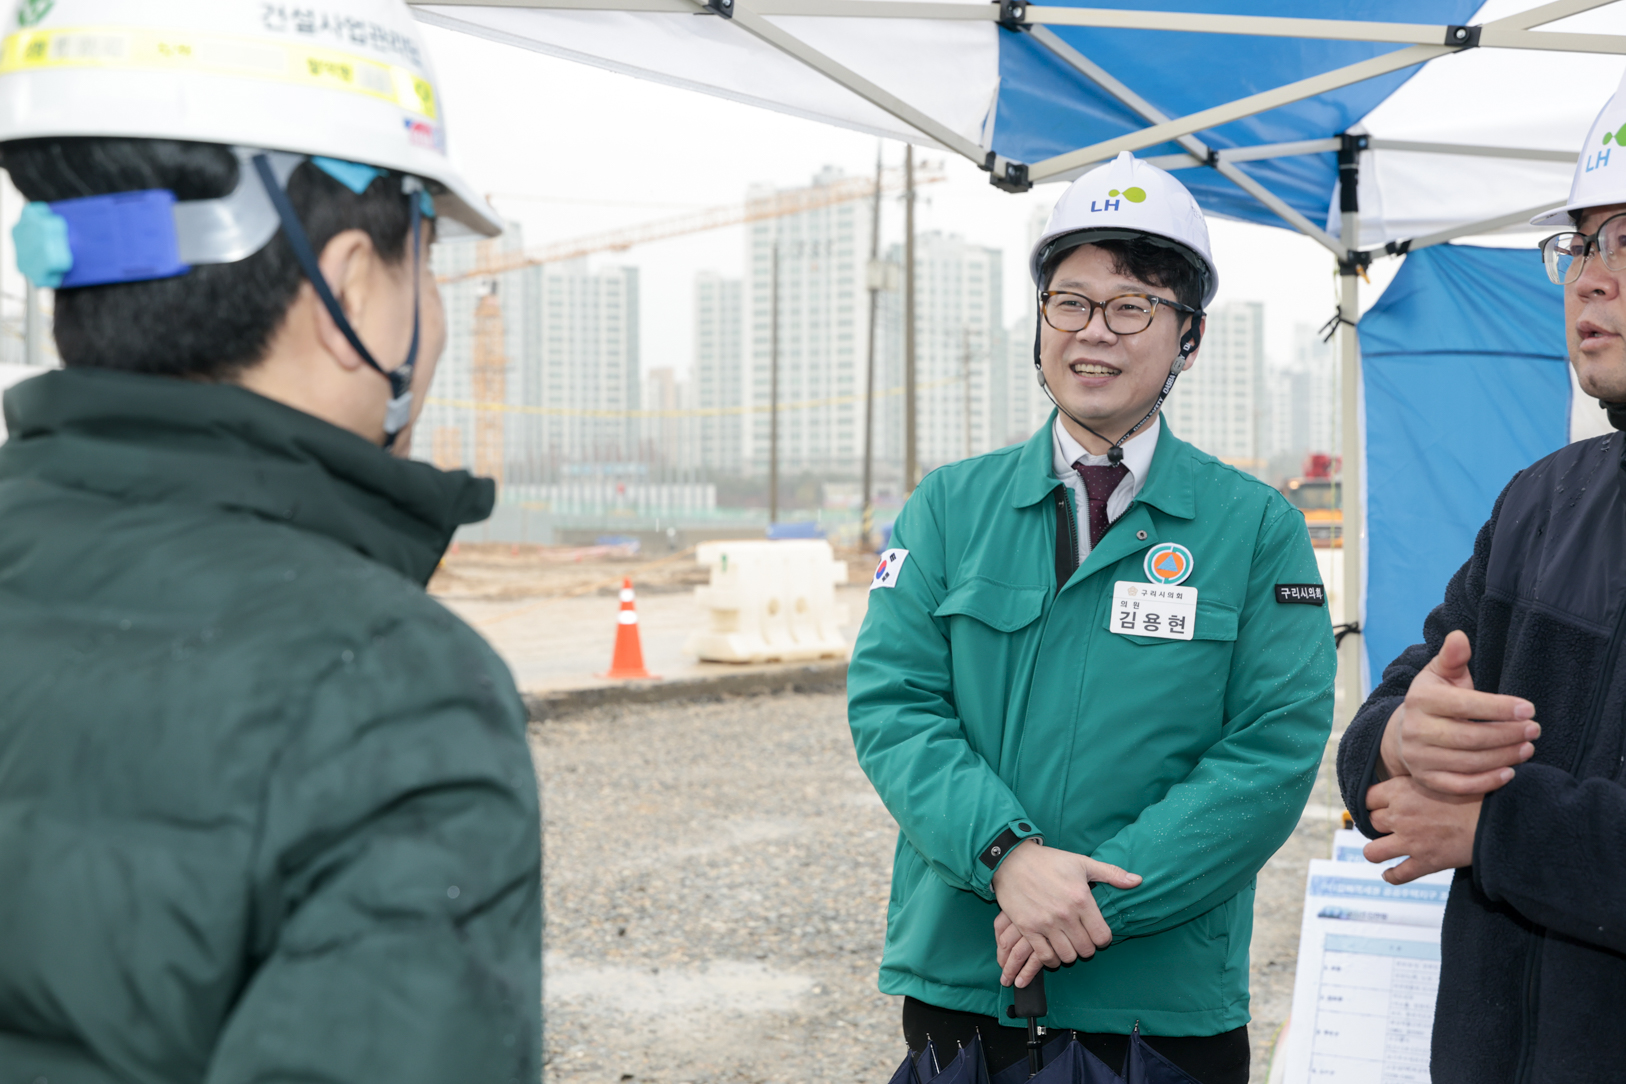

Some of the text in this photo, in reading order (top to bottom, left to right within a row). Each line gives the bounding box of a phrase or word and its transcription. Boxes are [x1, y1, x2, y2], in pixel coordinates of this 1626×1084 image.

[1585, 148, 1611, 173] LH
[1091, 199, 1120, 212] LH
[1141, 589, 1183, 599] 구리시의회
[1281, 587, 1322, 600] 구리시의회
[1119, 611, 1186, 634] 김용현
